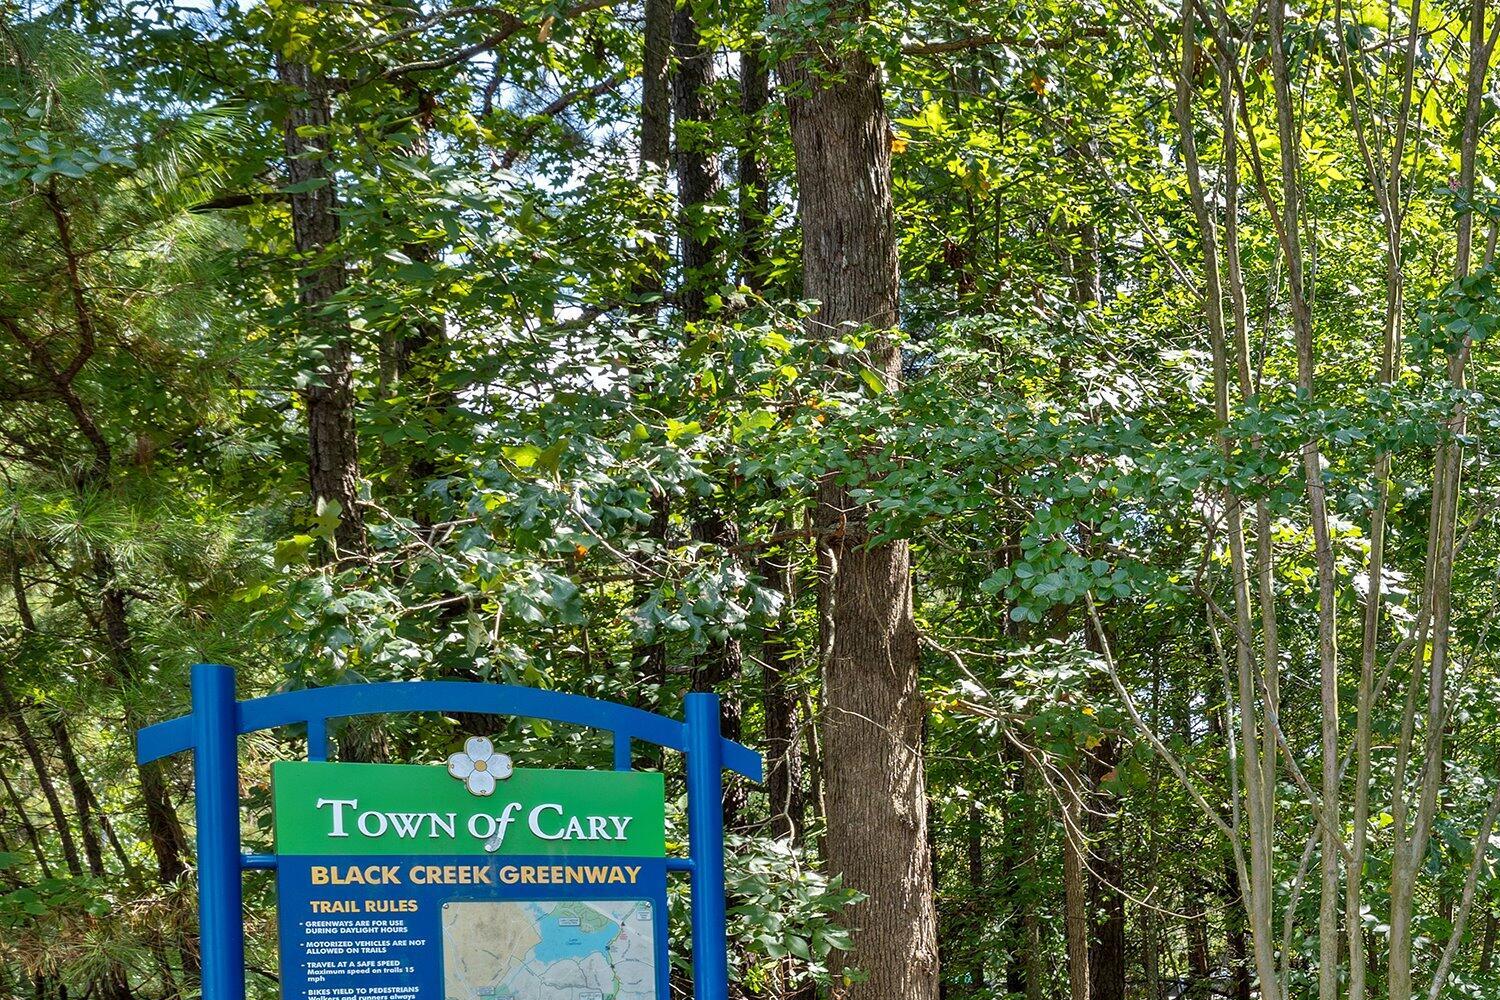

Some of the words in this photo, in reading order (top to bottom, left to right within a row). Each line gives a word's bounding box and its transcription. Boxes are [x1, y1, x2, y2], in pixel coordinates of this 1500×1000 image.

[468, 803, 522, 853] of
[311, 866, 402, 885] BLACK
[410, 866, 491, 884] CREEK
[499, 866, 642, 884] GREENWAY
[310, 901, 360, 913] TRAIL
[365, 900, 418, 912] RULES
[308, 975, 325, 983] mph
